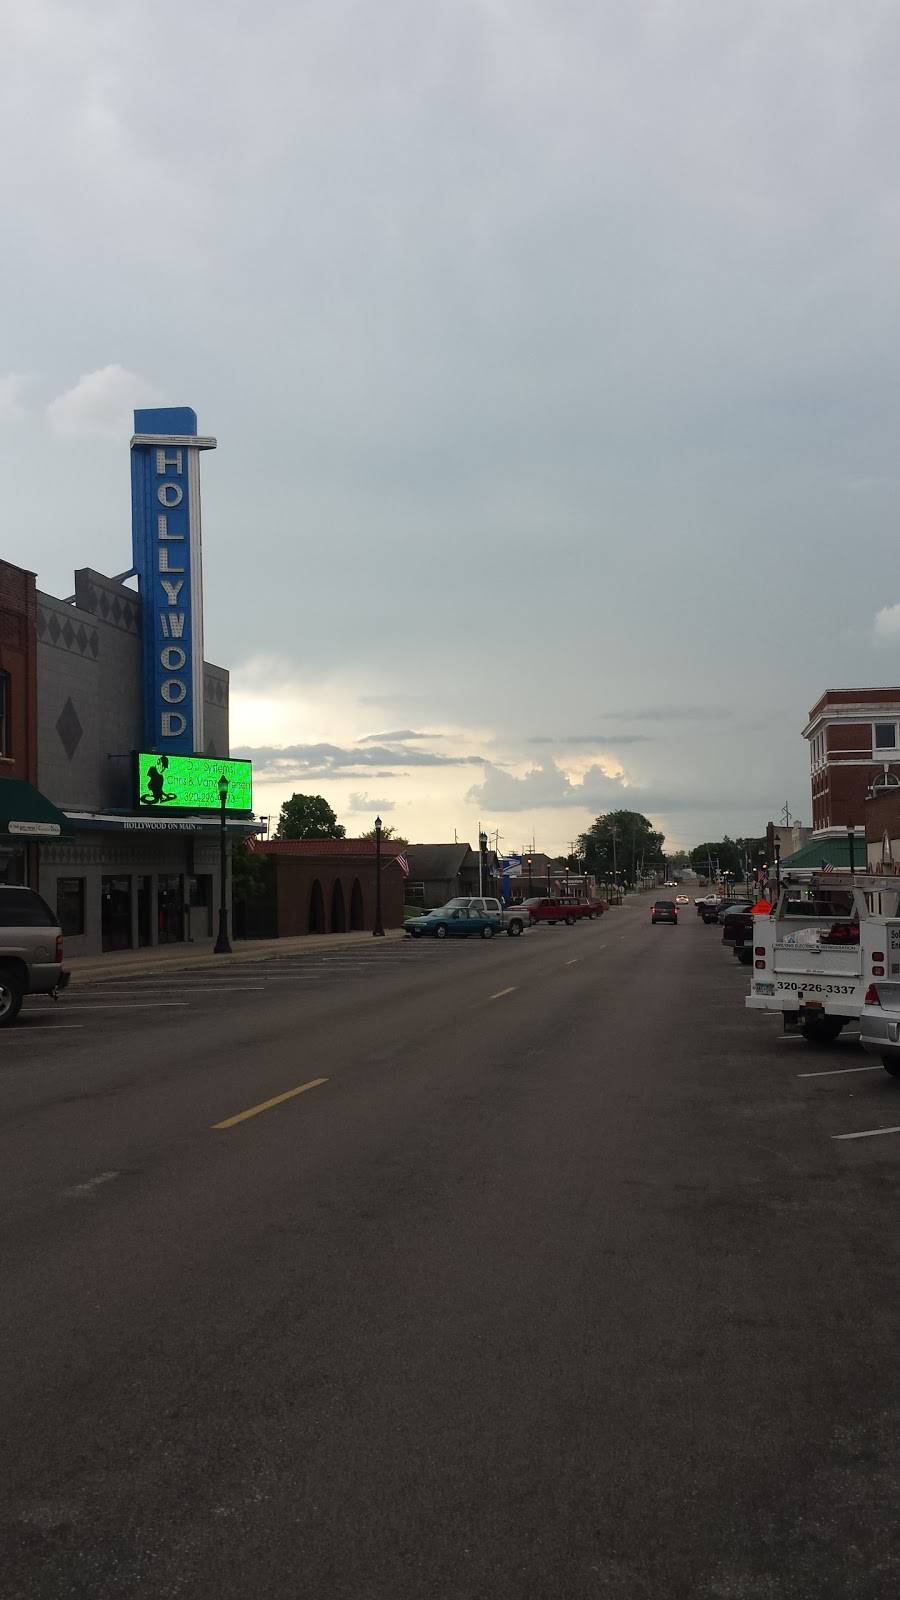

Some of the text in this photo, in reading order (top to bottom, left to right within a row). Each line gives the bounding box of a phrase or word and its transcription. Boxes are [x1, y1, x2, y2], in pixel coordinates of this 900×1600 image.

[156, 448, 187, 737] HOLLYWOOD
[123, 821, 167, 830] HOLLYWOOD
[167, 822, 178, 830] ON
[777, 981, 856, 995] 320-226-3337
